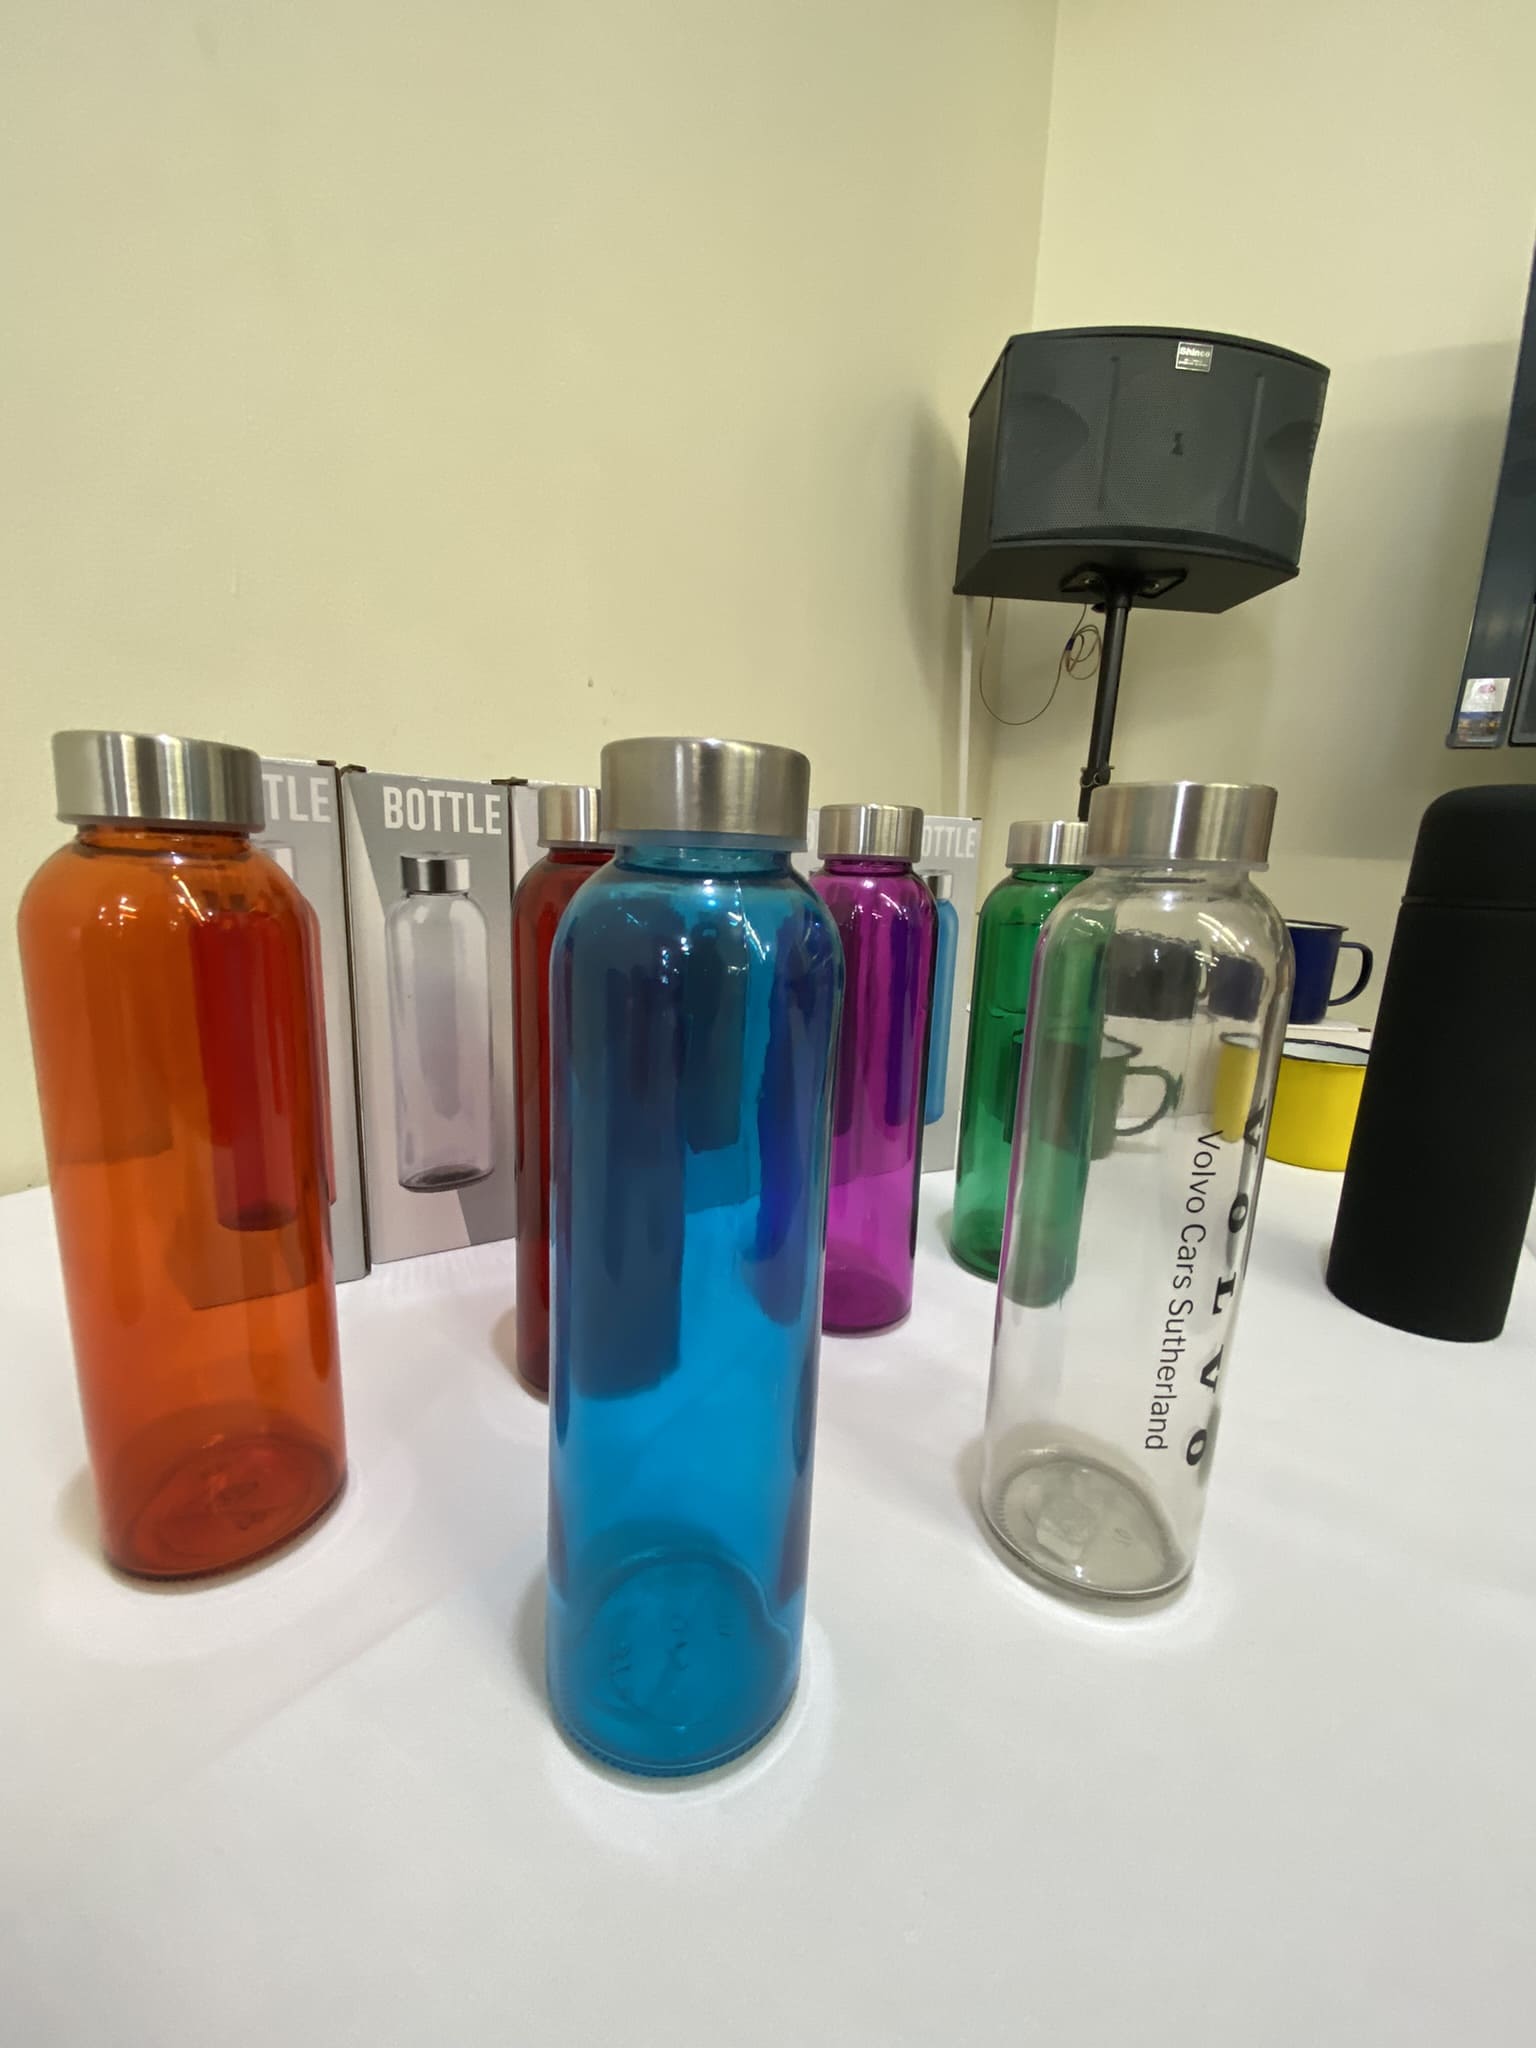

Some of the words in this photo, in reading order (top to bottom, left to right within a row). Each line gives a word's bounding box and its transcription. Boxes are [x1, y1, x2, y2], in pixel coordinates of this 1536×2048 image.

[1179, 346, 1210, 357] Shinco
[262, 774, 332, 823] TLE
[383, 786, 502, 835] BOTTLE
[921, 825, 977, 858] OTTLE
[1185, 1129, 1224, 1214] Volvo
[1172, 1223, 1207, 1290] Cars
[1144, 1298, 1194, 1451] Sutherland
